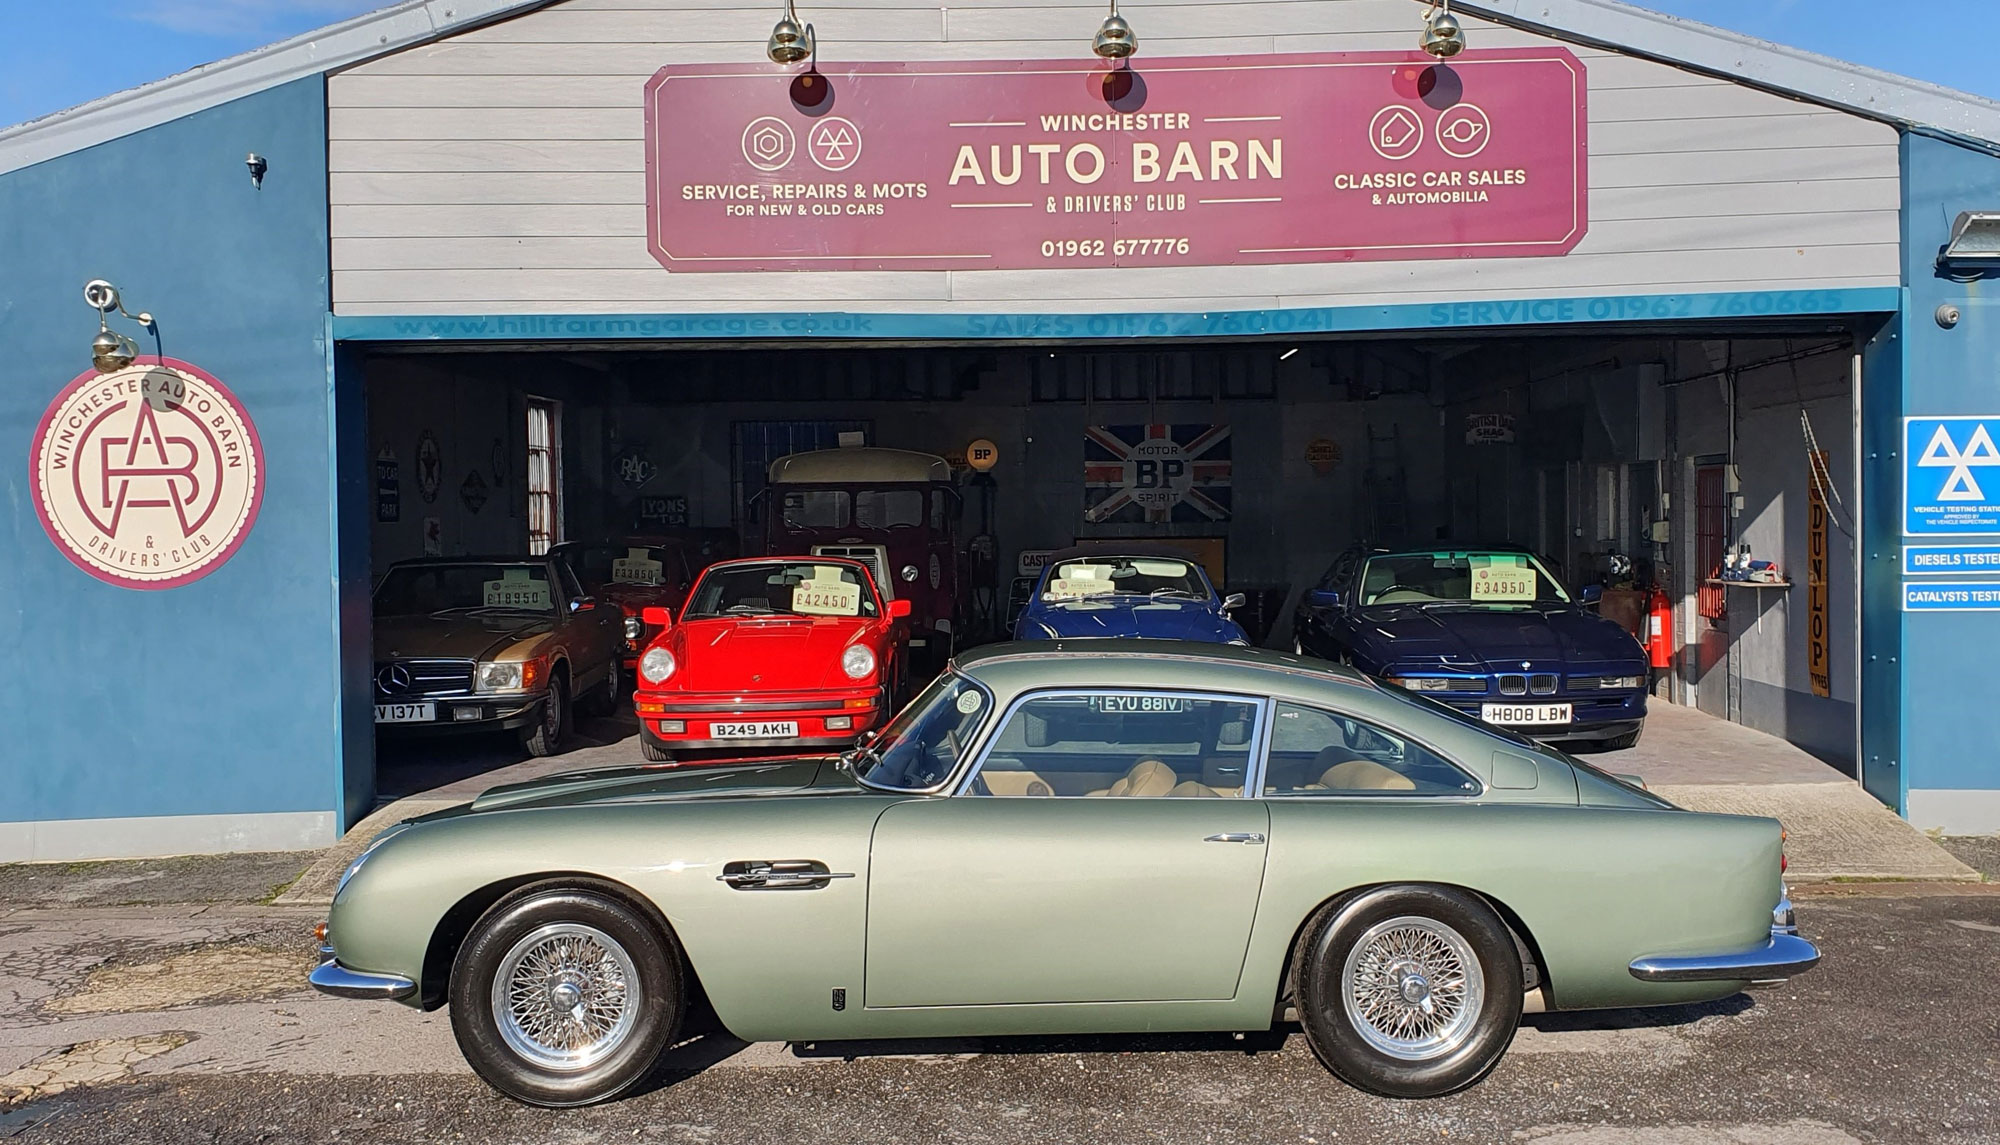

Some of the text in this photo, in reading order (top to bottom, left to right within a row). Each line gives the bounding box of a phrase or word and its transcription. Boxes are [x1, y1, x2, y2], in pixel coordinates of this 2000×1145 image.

[1040, 113, 1191, 132] WINCHESTER
[948, 138, 1283, 186] AUTO BARN
[1334, 169, 1526, 190] CLASSIC CAR SALES
[681, 182, 927, 202] SERVICE, REPAIRS & MOTS
[1371, 190, 1489, 206] & AUTOMOBILIA
[726, 202, 884, 216] FOR NEW & OLD CARS
[1046, 193, 1187, 214] & DRIVERS' CLUB
[1041, 237, 1190, 257] 01962 677776
[1429, 299, 1574, 325] SERVICE
[53, 379, 242, 469] WINCHESTER AUTO BARN
[975, 449, 991, 460] BP
[1138, 446, 1178, 454] MOTOR
[621, 455, 649, 482] RAC
[1138, 493, 1179, 502] SPIRIT
[145, 535, 154, 548] &
[88, 534, 211, 567] DRIVERS' CLUB
[1914, 554, 1961, 566] DIESELS
[1475, 581, 1525, 594] £34950
[1812, 503, 1823, 667] DUNLOP
[488, 592, 539, 605] £18950
[796, 593, 847, 608] £42450
[1908, 591, 1969, 602] CATALYSTS
[1105, 696, 1138, 711] EYU
[391, 704, 426, 719] 137T
[1492, 706, 1568, 721] H808 LBW
[717, 723, 791, 736] B249 AKH
